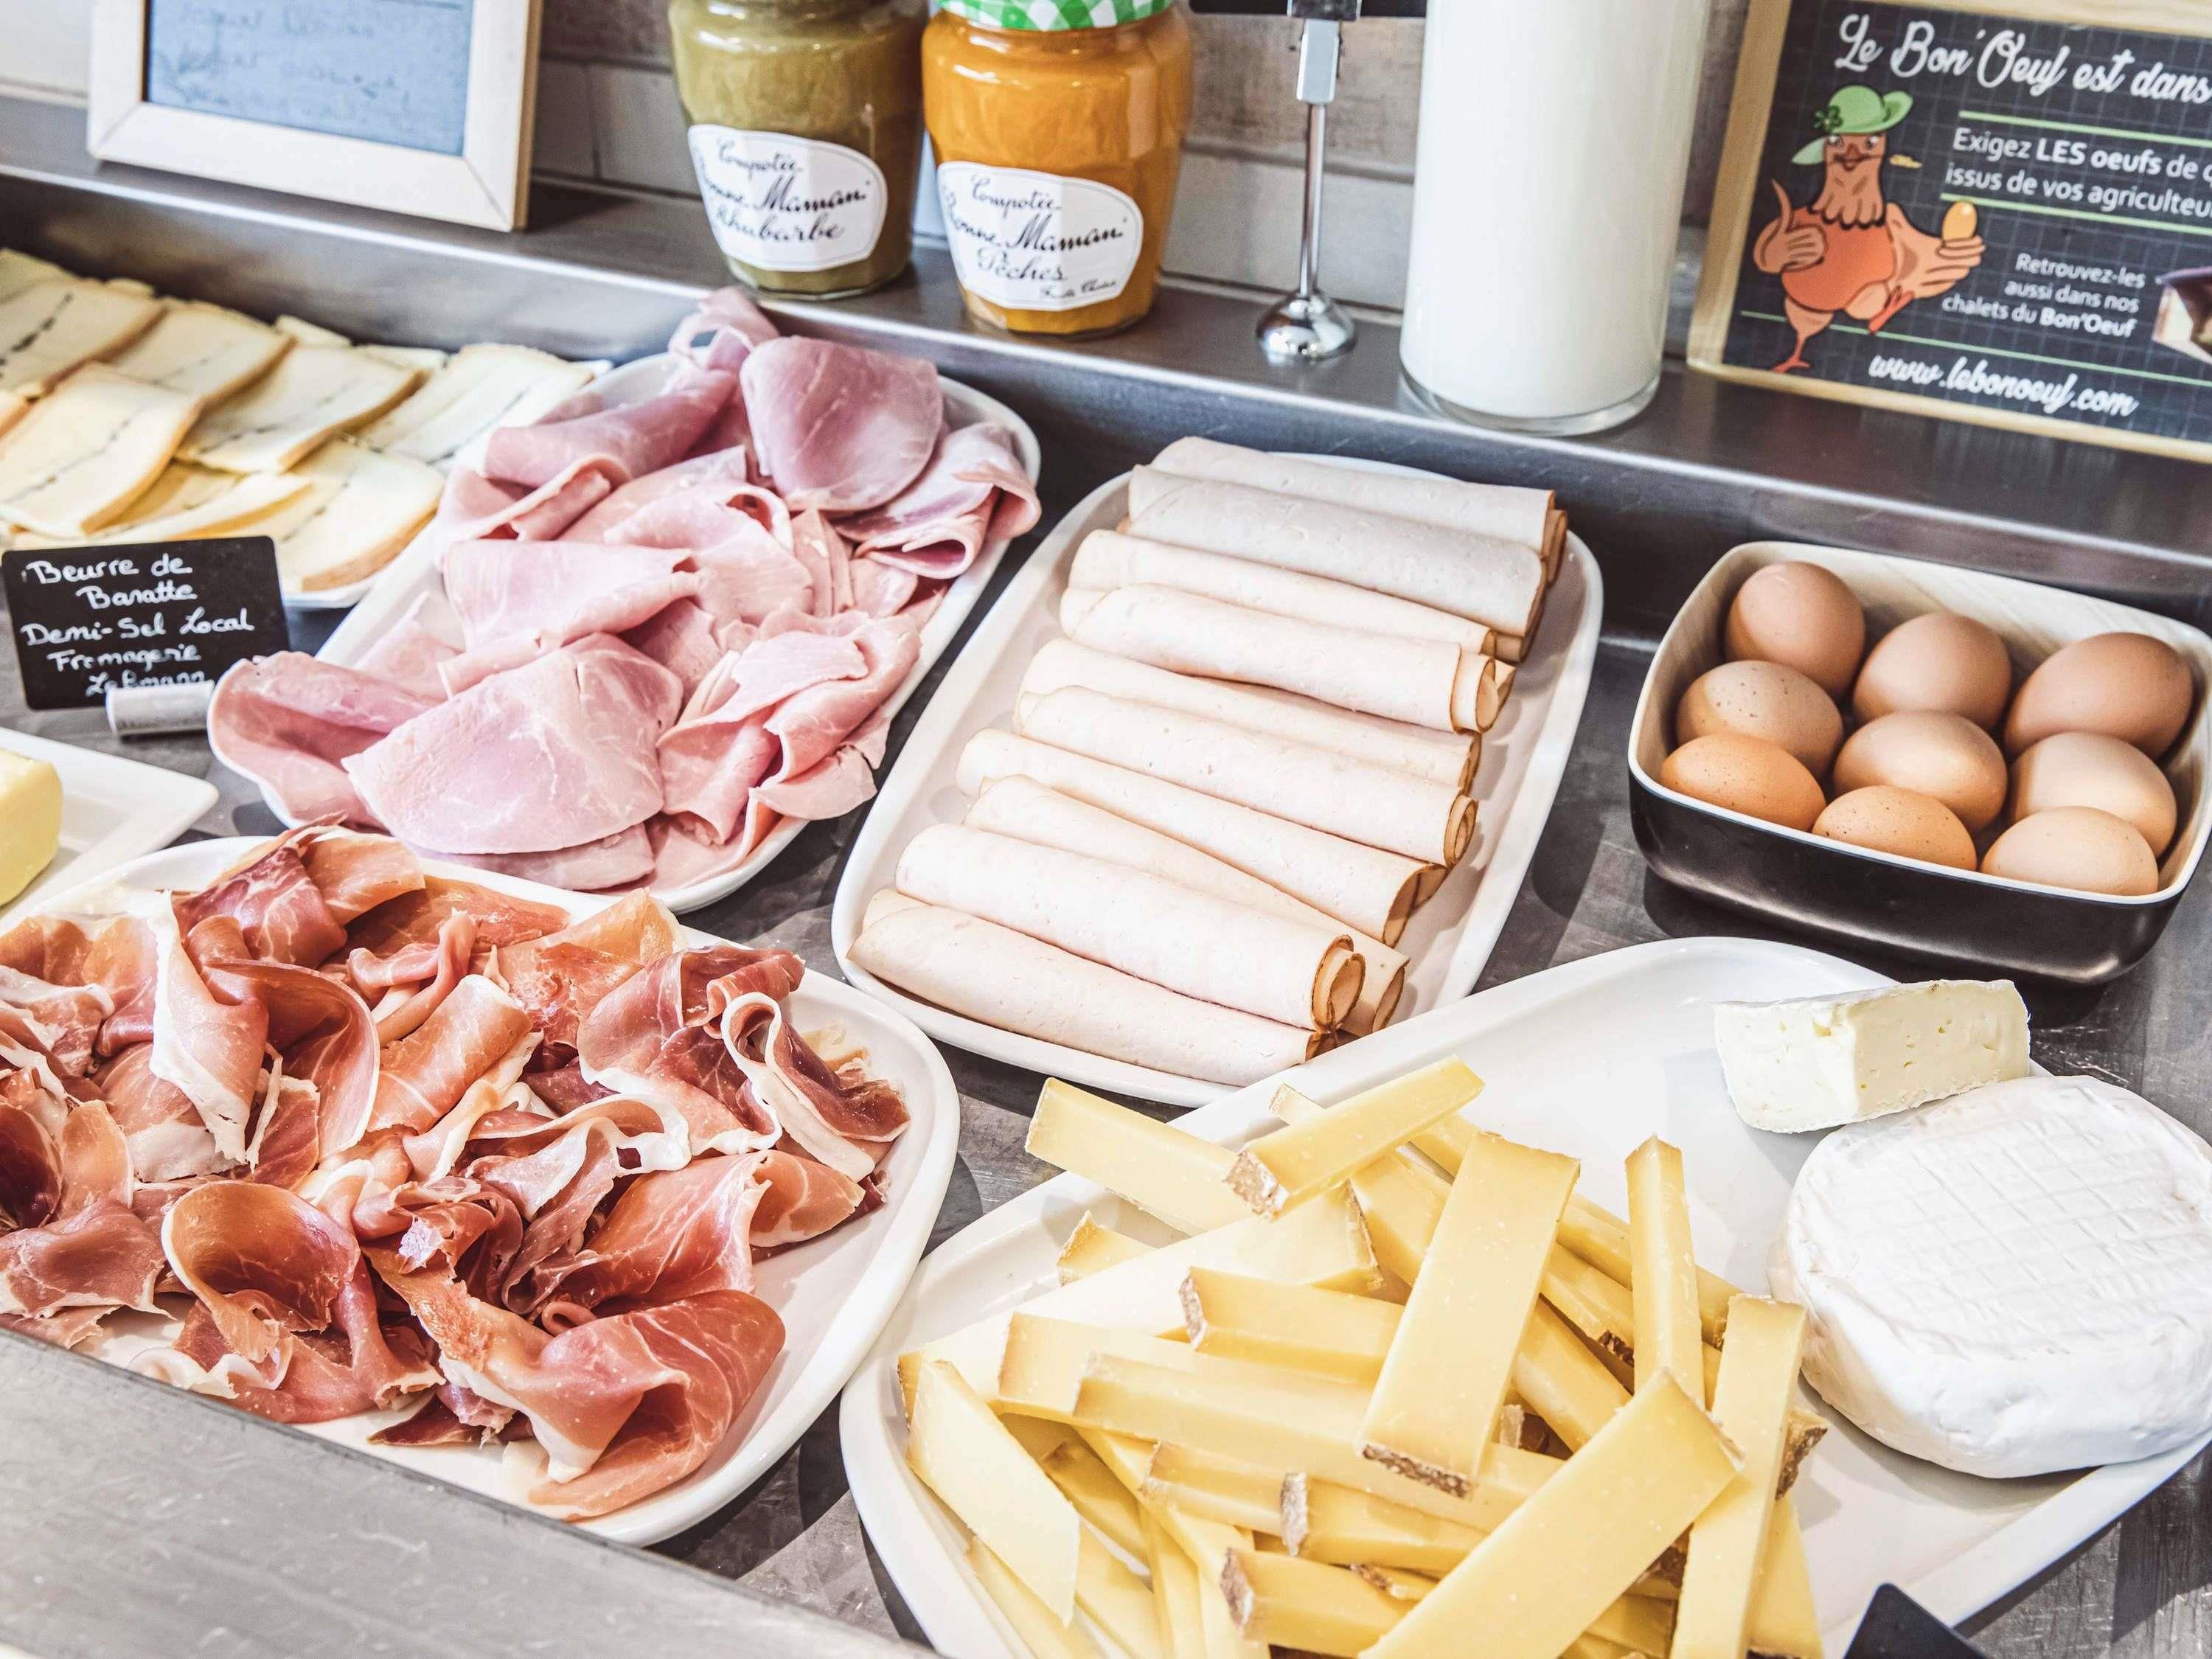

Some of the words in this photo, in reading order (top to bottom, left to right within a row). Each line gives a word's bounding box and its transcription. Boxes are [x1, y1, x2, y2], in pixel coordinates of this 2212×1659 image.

[1834, 14, 1883, 72] Le
[2073, 48, 2135, 93] est
[2130, 61, 2212, 104] dans
[1953, 127, 2032, 162] Exigez
[2036, 138, 2087, 166] LES
[2090, 149, 2163, 175] oeufs
[2166, 154, 2199, 180] de
[752, 174, 872, 212] Maman
[1945, 161, 2003, 191] issus
[2006, 170, 2038, 195] de
[2043, 179, 2084, 201] vos
[2087, 185, 2212, 218] agriculteu
[1005, 212, 1127, 251] Maman
[2015, 252, 2146, 289] Retrouvez-les
[1941, 293, 2009, 320] chalets
[2011, 302, 2037, 324] du
[2039, 306, 2138, 338] Bon'Oeuf
[2004, 280, 2053, 301] aussi
[2054, 284, 2101, 308] dans
[2104, 294, 2140, 314] nos
[1868, 355, 2140, 417] www.lebonoeuf.com
[25, 558, 140, 585] Beurre
[150, 552, 193, 577] de
[76, 579, 198, 610] Baratte
[179, 606, 255, 636] Local
[46, 643, 202, 672] Fromagerie
